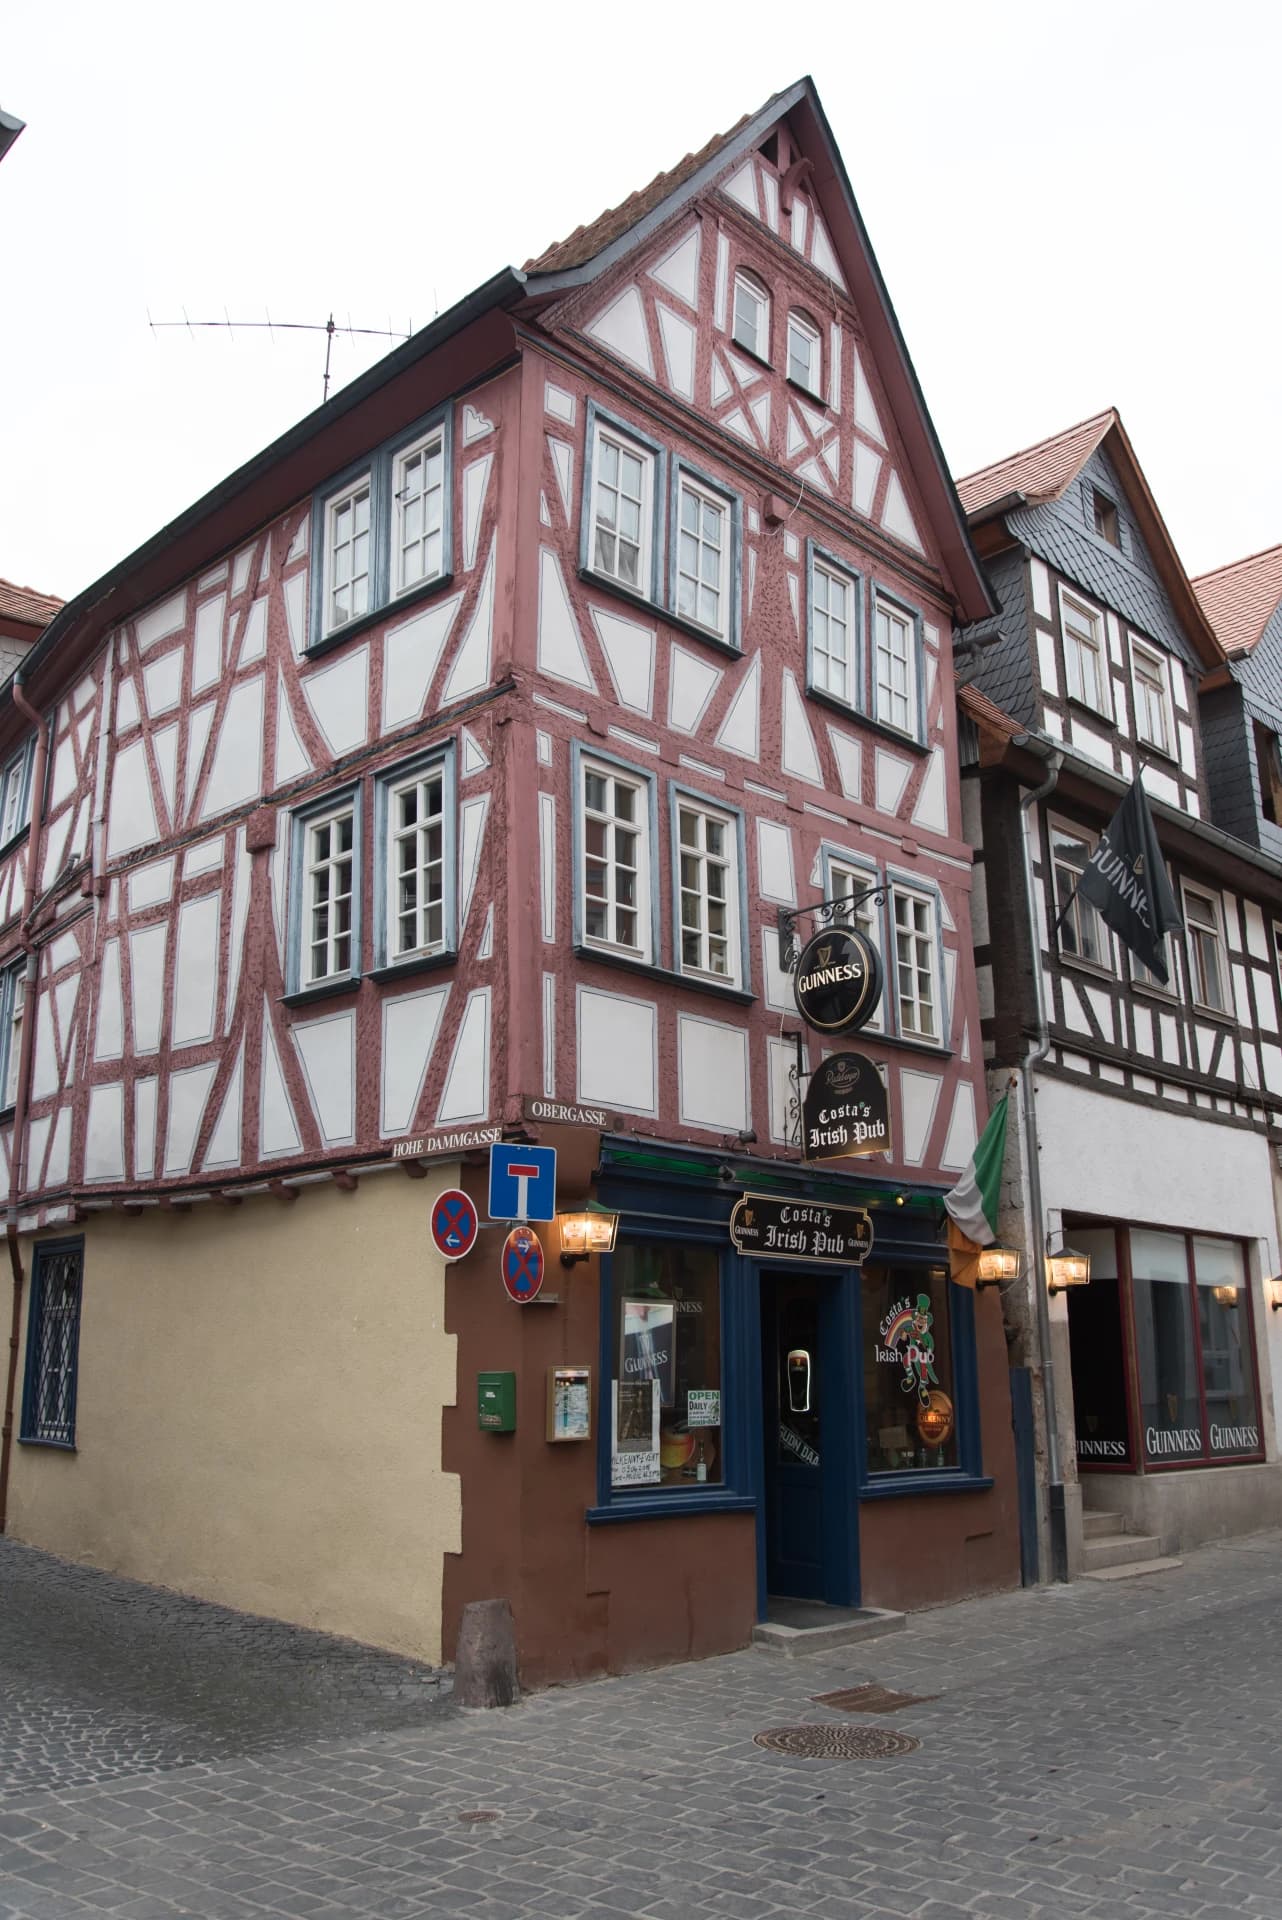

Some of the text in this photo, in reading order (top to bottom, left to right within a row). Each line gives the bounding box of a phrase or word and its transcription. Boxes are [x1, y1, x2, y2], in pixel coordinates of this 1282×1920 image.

[799, 963, 862, 993] GUINNESS
[531, 1101, 607, 1126] OBERGASSE
[819, 1102, 871, 1124] Costa's
[393, 1127, 502, 1158] HOHE DAMMGASSE
[809, 1119, 885, 1148] Irish Pub
[780, 1206, 832, 1227] Costa's
[735, 1226, 759, 1237] GUINNESS
[764, 1225, 844, 1255] Irish Pub
[879, 1296, 911, 1336] Costa's
[874, 1344, 935, 1363] Irish Pub
[689, 1391, 720, 1401] OPEN
[920, 1415, 951, 1425] ILKENNY
[1146, 1427, 1201, 1454] GUINNESS
[1210, 1424, 1258, 1449] GUINNESS
